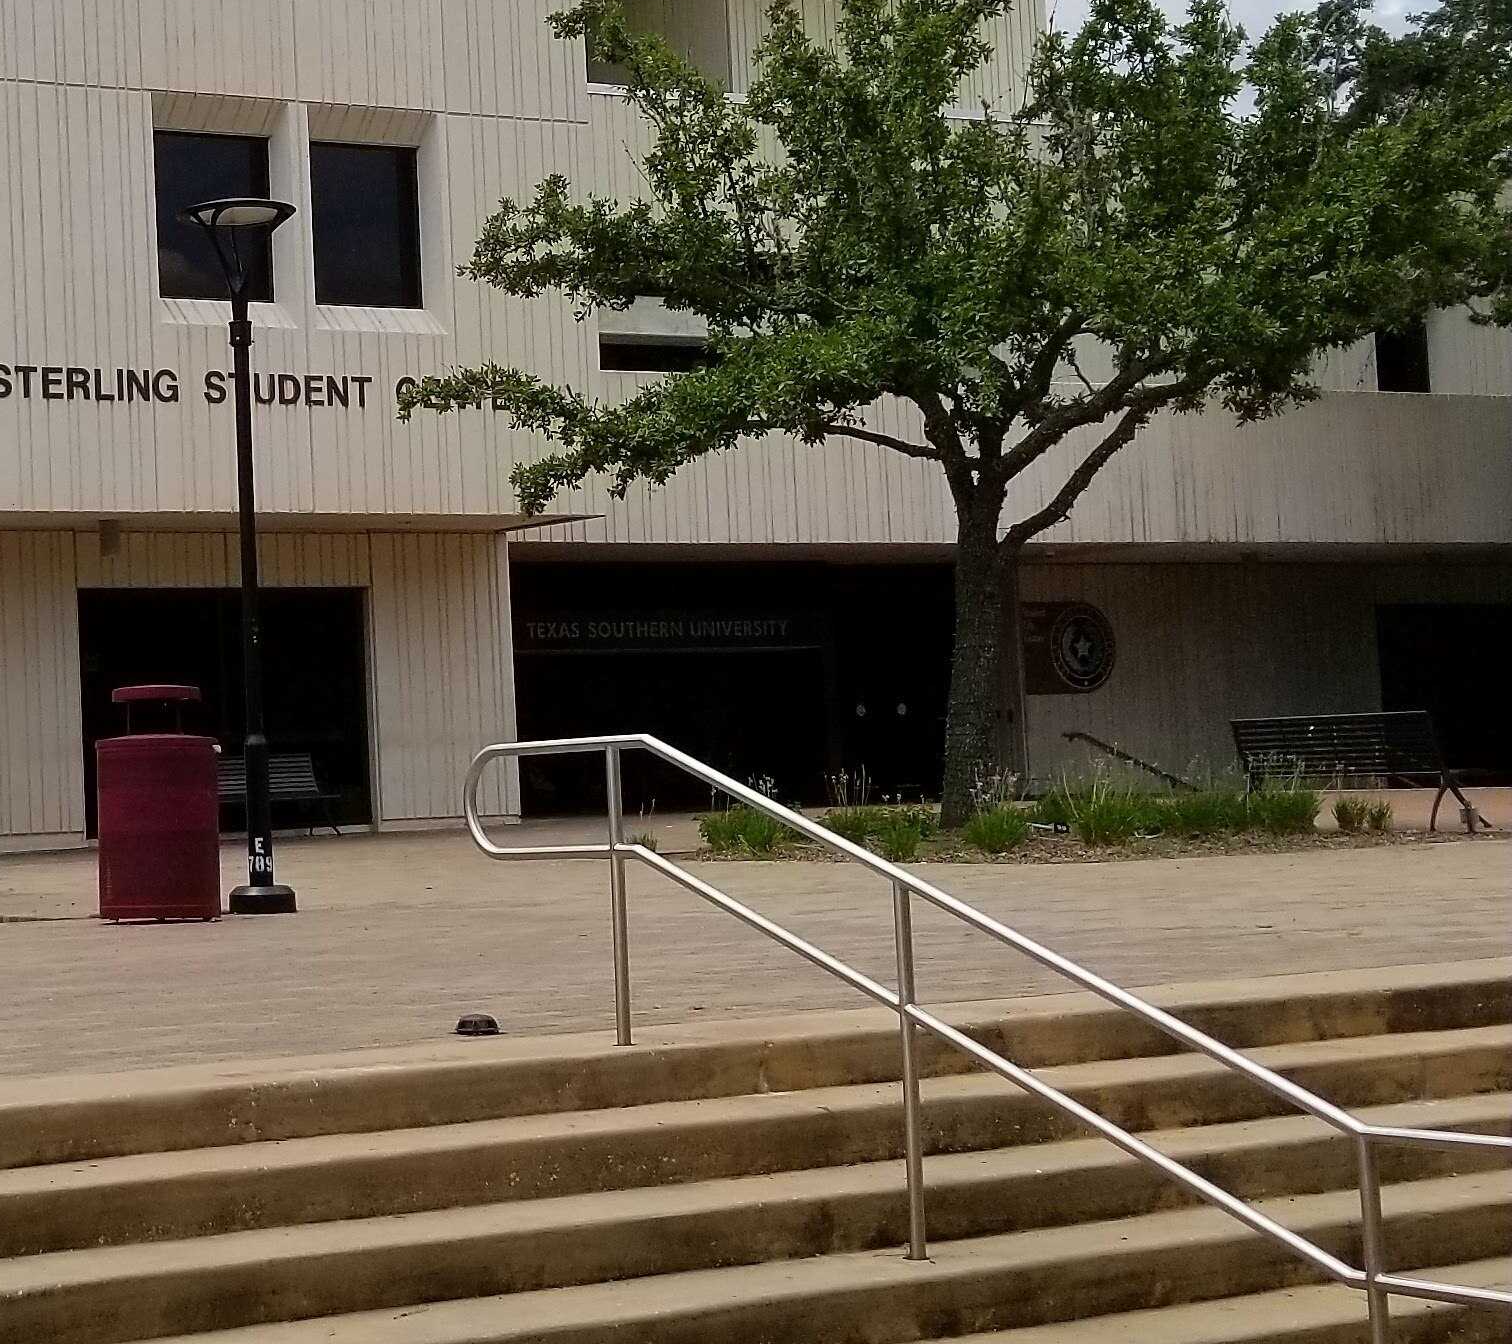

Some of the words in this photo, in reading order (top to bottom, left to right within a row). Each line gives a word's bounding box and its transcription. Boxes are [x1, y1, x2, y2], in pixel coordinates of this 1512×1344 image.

[203, 370, 373, 410] SUDENT
[526, 621, 580, 639] TEXAS
[586, 620, 682, 639] SOUTHERN
[689, 619, 789, 638] UNIVERSITY
[254, 837, 265, 854] E
